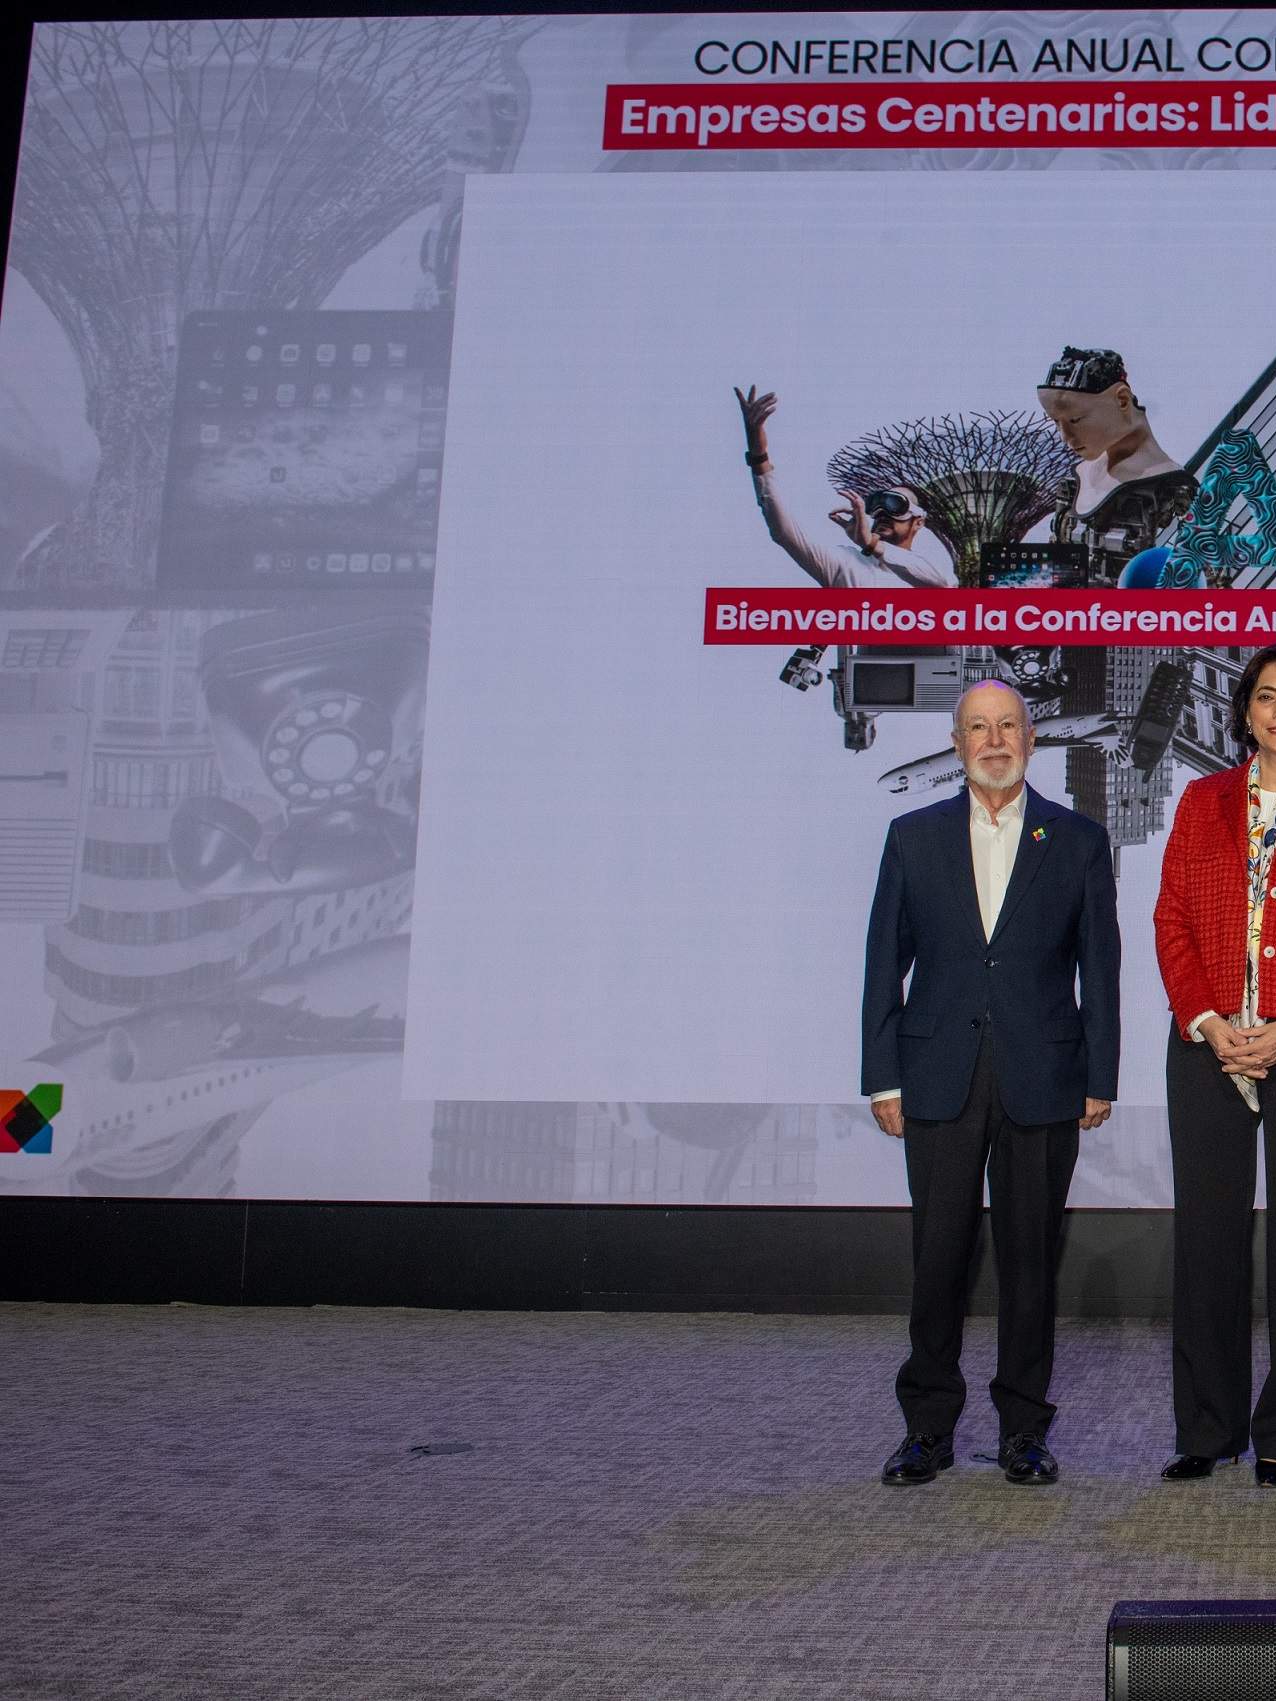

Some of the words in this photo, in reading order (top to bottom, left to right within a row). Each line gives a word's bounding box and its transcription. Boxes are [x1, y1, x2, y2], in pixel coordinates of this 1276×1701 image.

[695, 39, 1018, 74] CONFERENCIA
[1032, 38, 1184, 73] ANUAL
[622, 99, 865, 145] Empresas
[878, 92, 1198, 133] Centenarias:
[715, 601, 936, 631] Bienvenidos
[943, 609, 967, 632] a
[975, 603, 1007, 632] la
[1014, 602, 1237, 633] Conferencia
